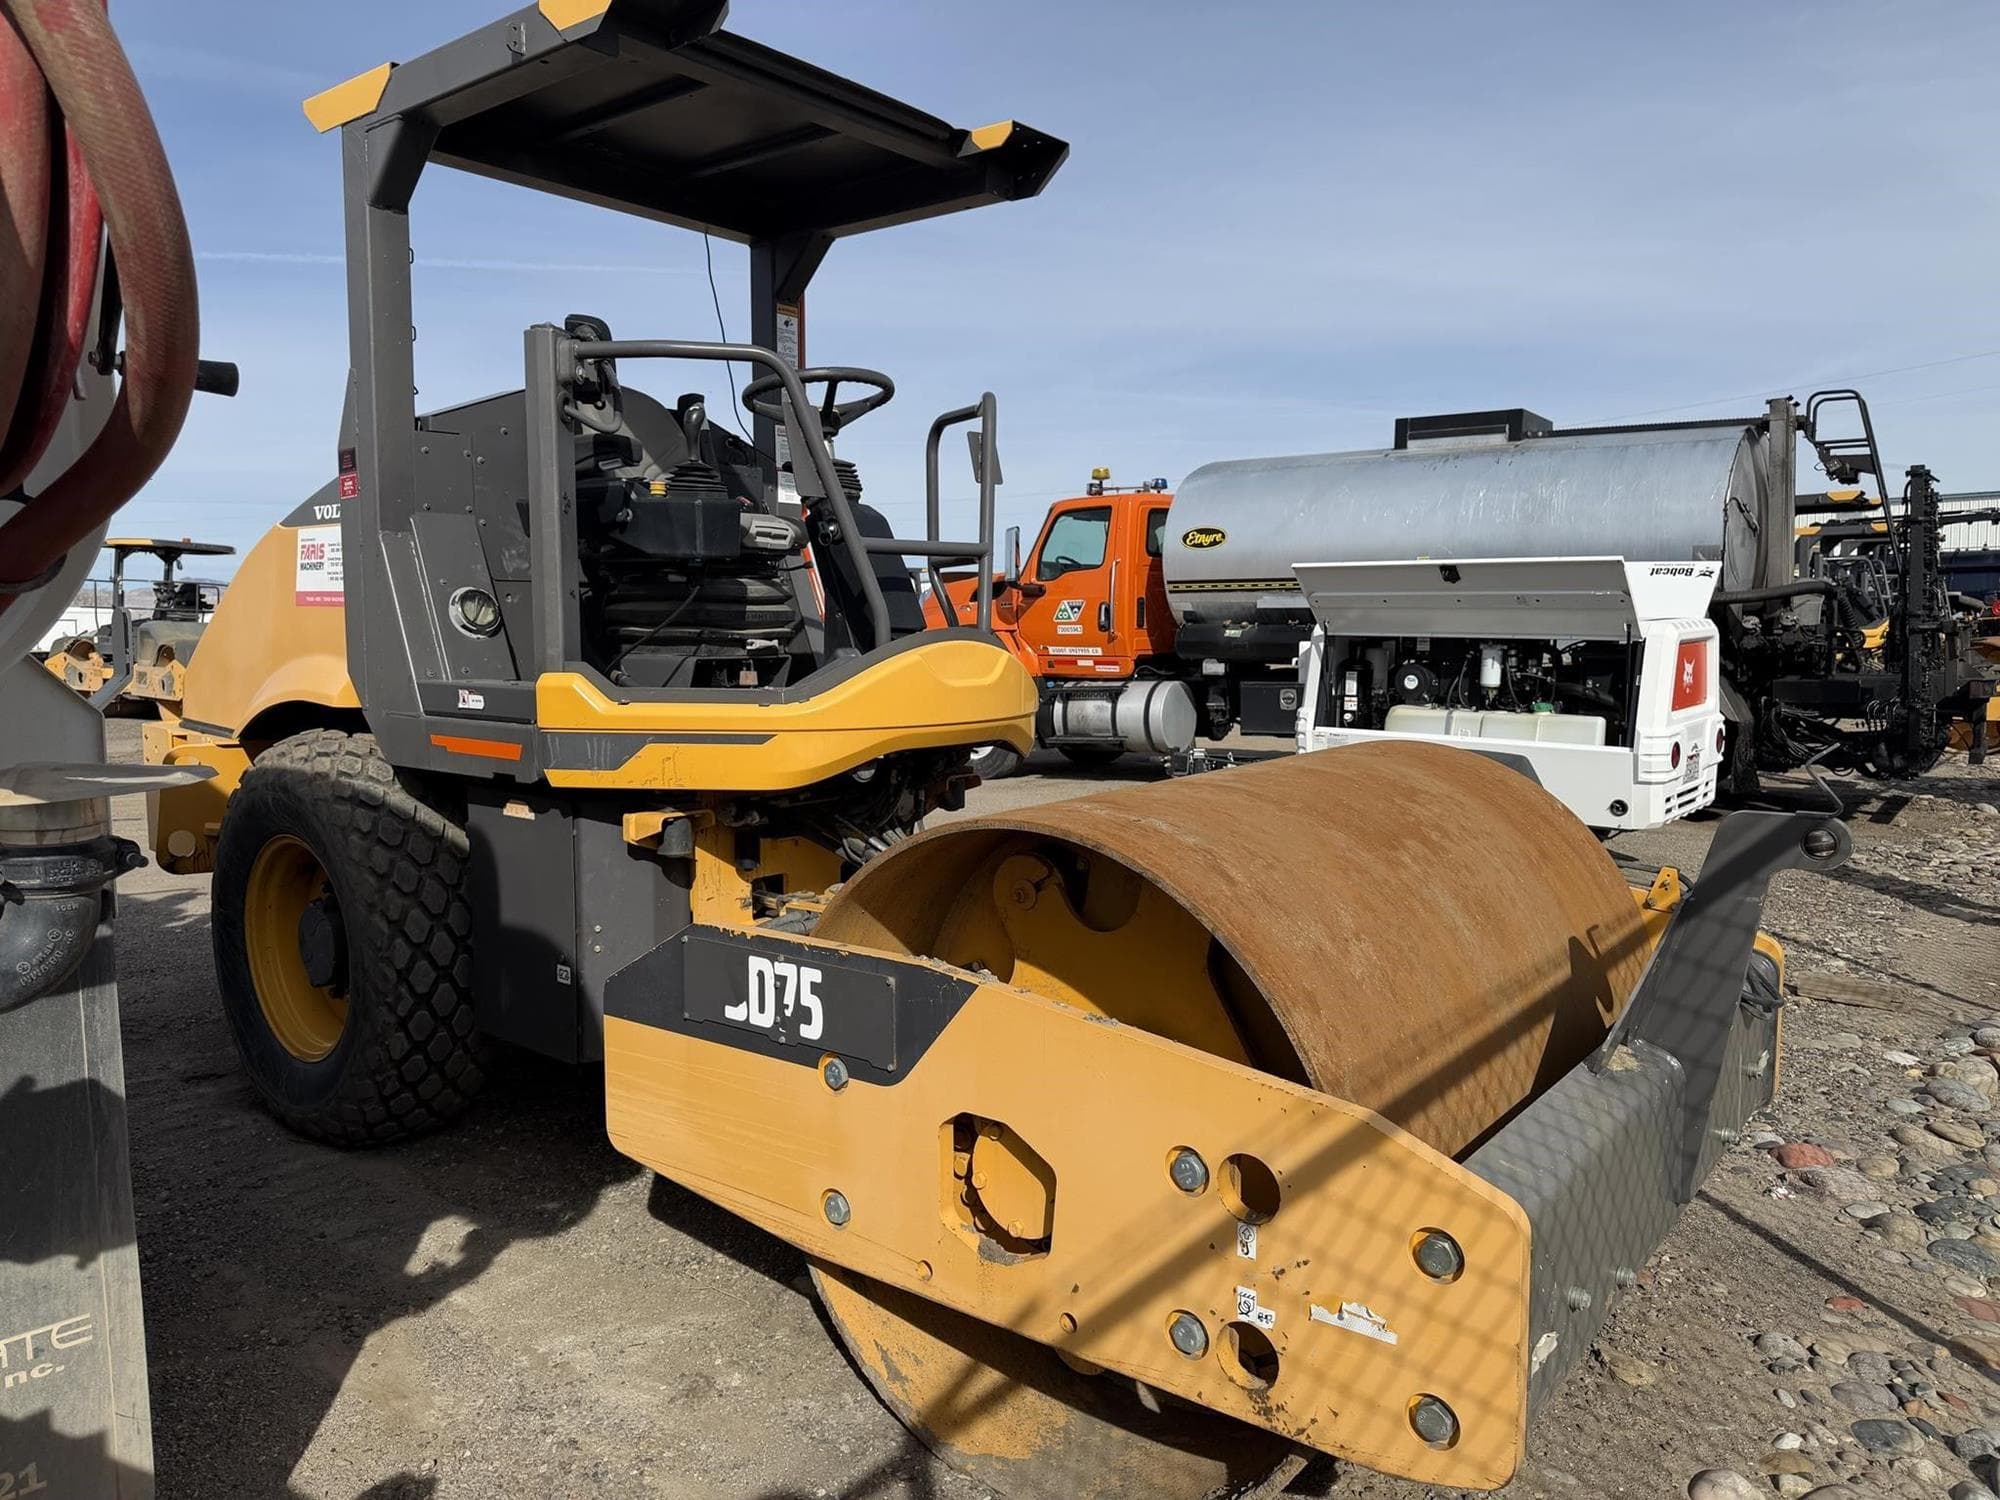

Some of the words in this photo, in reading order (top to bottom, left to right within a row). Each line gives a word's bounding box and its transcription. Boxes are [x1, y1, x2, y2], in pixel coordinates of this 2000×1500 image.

[313, 503, 341, 521] VOL
[1186, 531, 1223, 546] Etnyre
[300, 542, 325, 561] FARIS
[1649, 567, 1695, 577] Bobcat
[1057, 611, 1069, 619] CO
[5, 1363, 65, 1388] nc.
